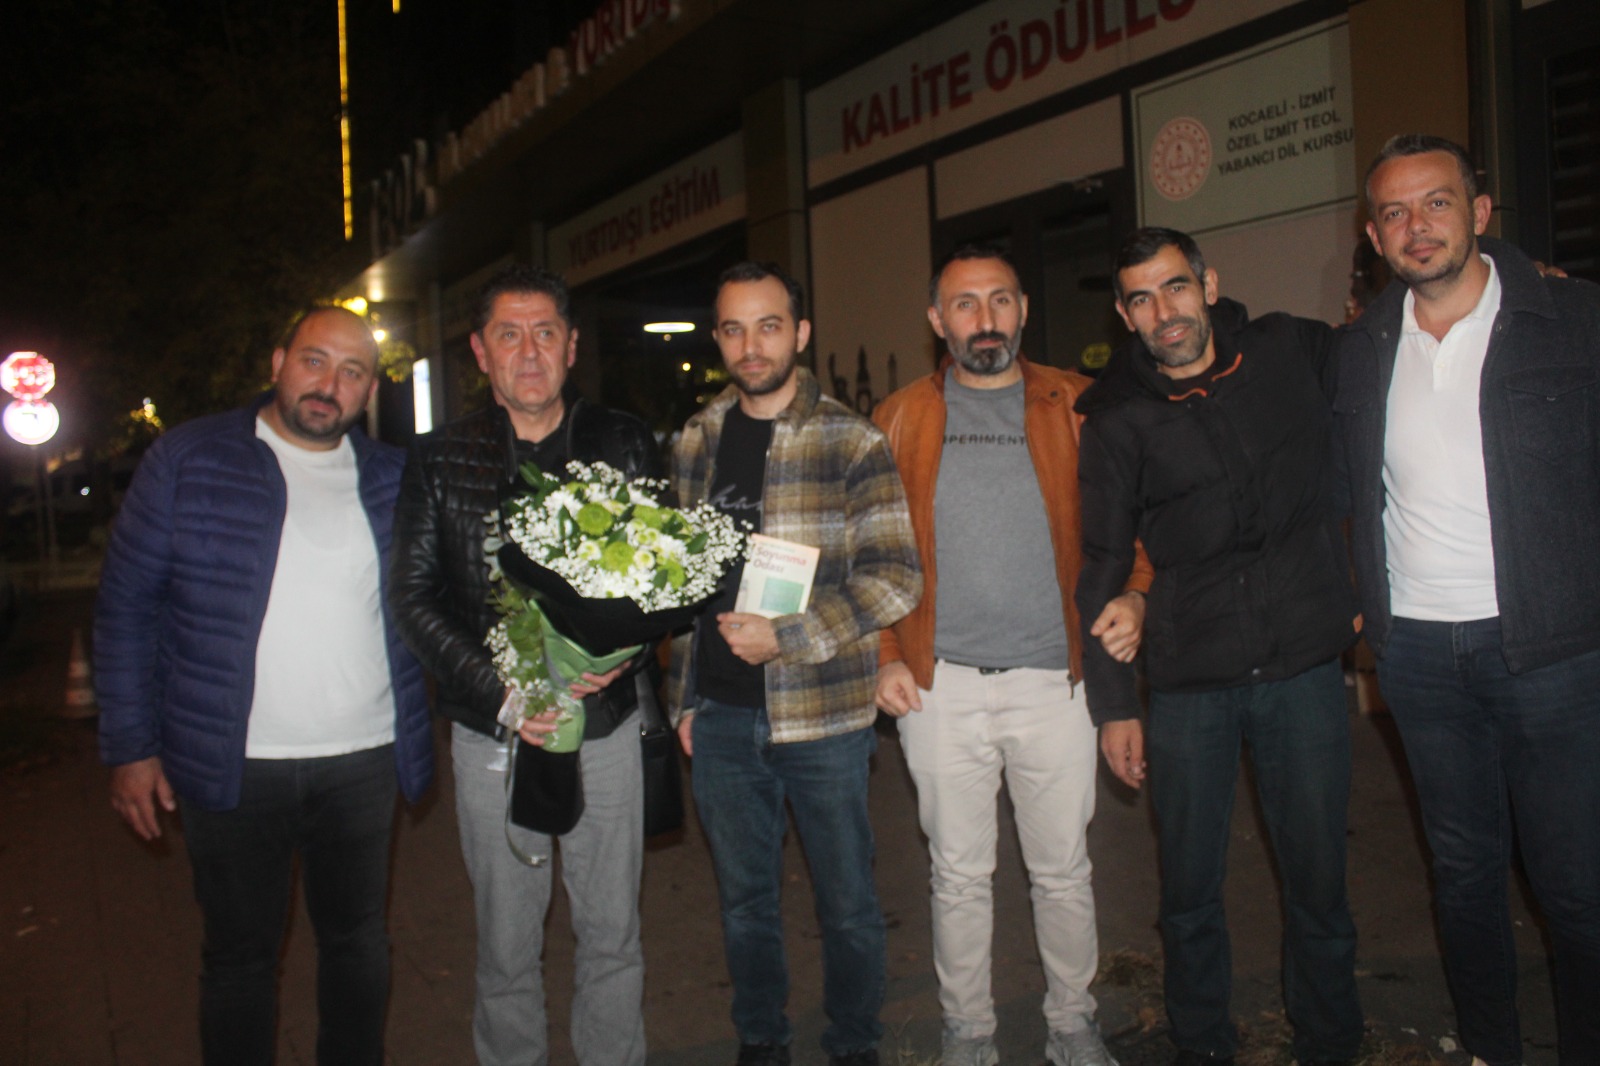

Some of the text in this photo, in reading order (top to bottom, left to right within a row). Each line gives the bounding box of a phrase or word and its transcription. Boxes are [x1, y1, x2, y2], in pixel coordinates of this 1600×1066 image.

[842, 52, 973, 154] KALİTE
[1228, 100, 1288, 131] KOCAELİ
[1298, 86, 1337, 110] İZMİT
[1217, 127, 1354, 176] YABANCI DİL KURSU
[1226, 109, 1342, 153] ÖZEL İZMİT TEOL
[568, 165, 722, 269] YURTDIŞI EĞİTİM
